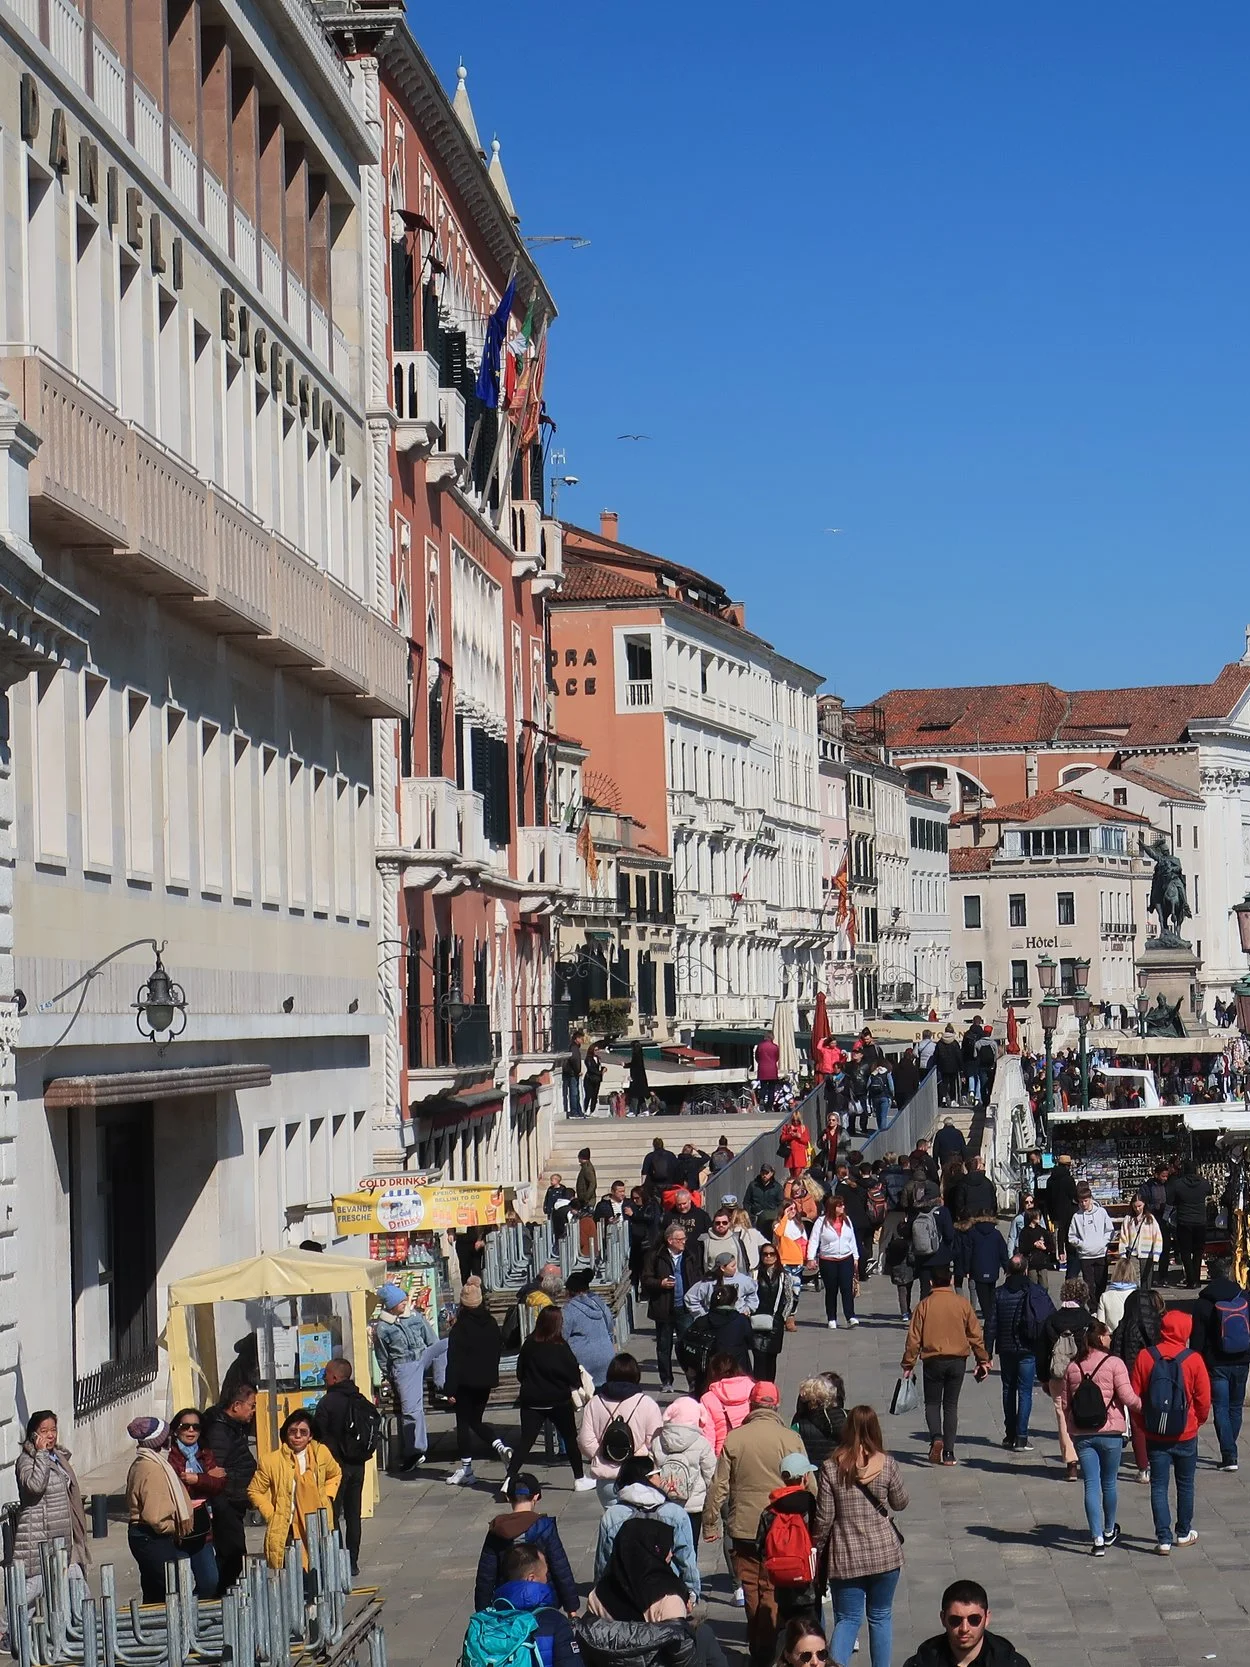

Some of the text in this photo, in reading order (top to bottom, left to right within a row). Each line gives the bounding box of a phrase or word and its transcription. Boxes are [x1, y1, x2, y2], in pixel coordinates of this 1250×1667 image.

[20, 72, 345, 456] DANIELI EXCELSIOR
[1025, 935, 1059, 949] Hôtel
[359, 1176, 427, 1189] COLD DRINKS
[336, 1204, 373, 1214] BEVANDE
[337, 1214, 372, 1223] FRESCHE
[388, 1216, 421, 1230] Drinks
